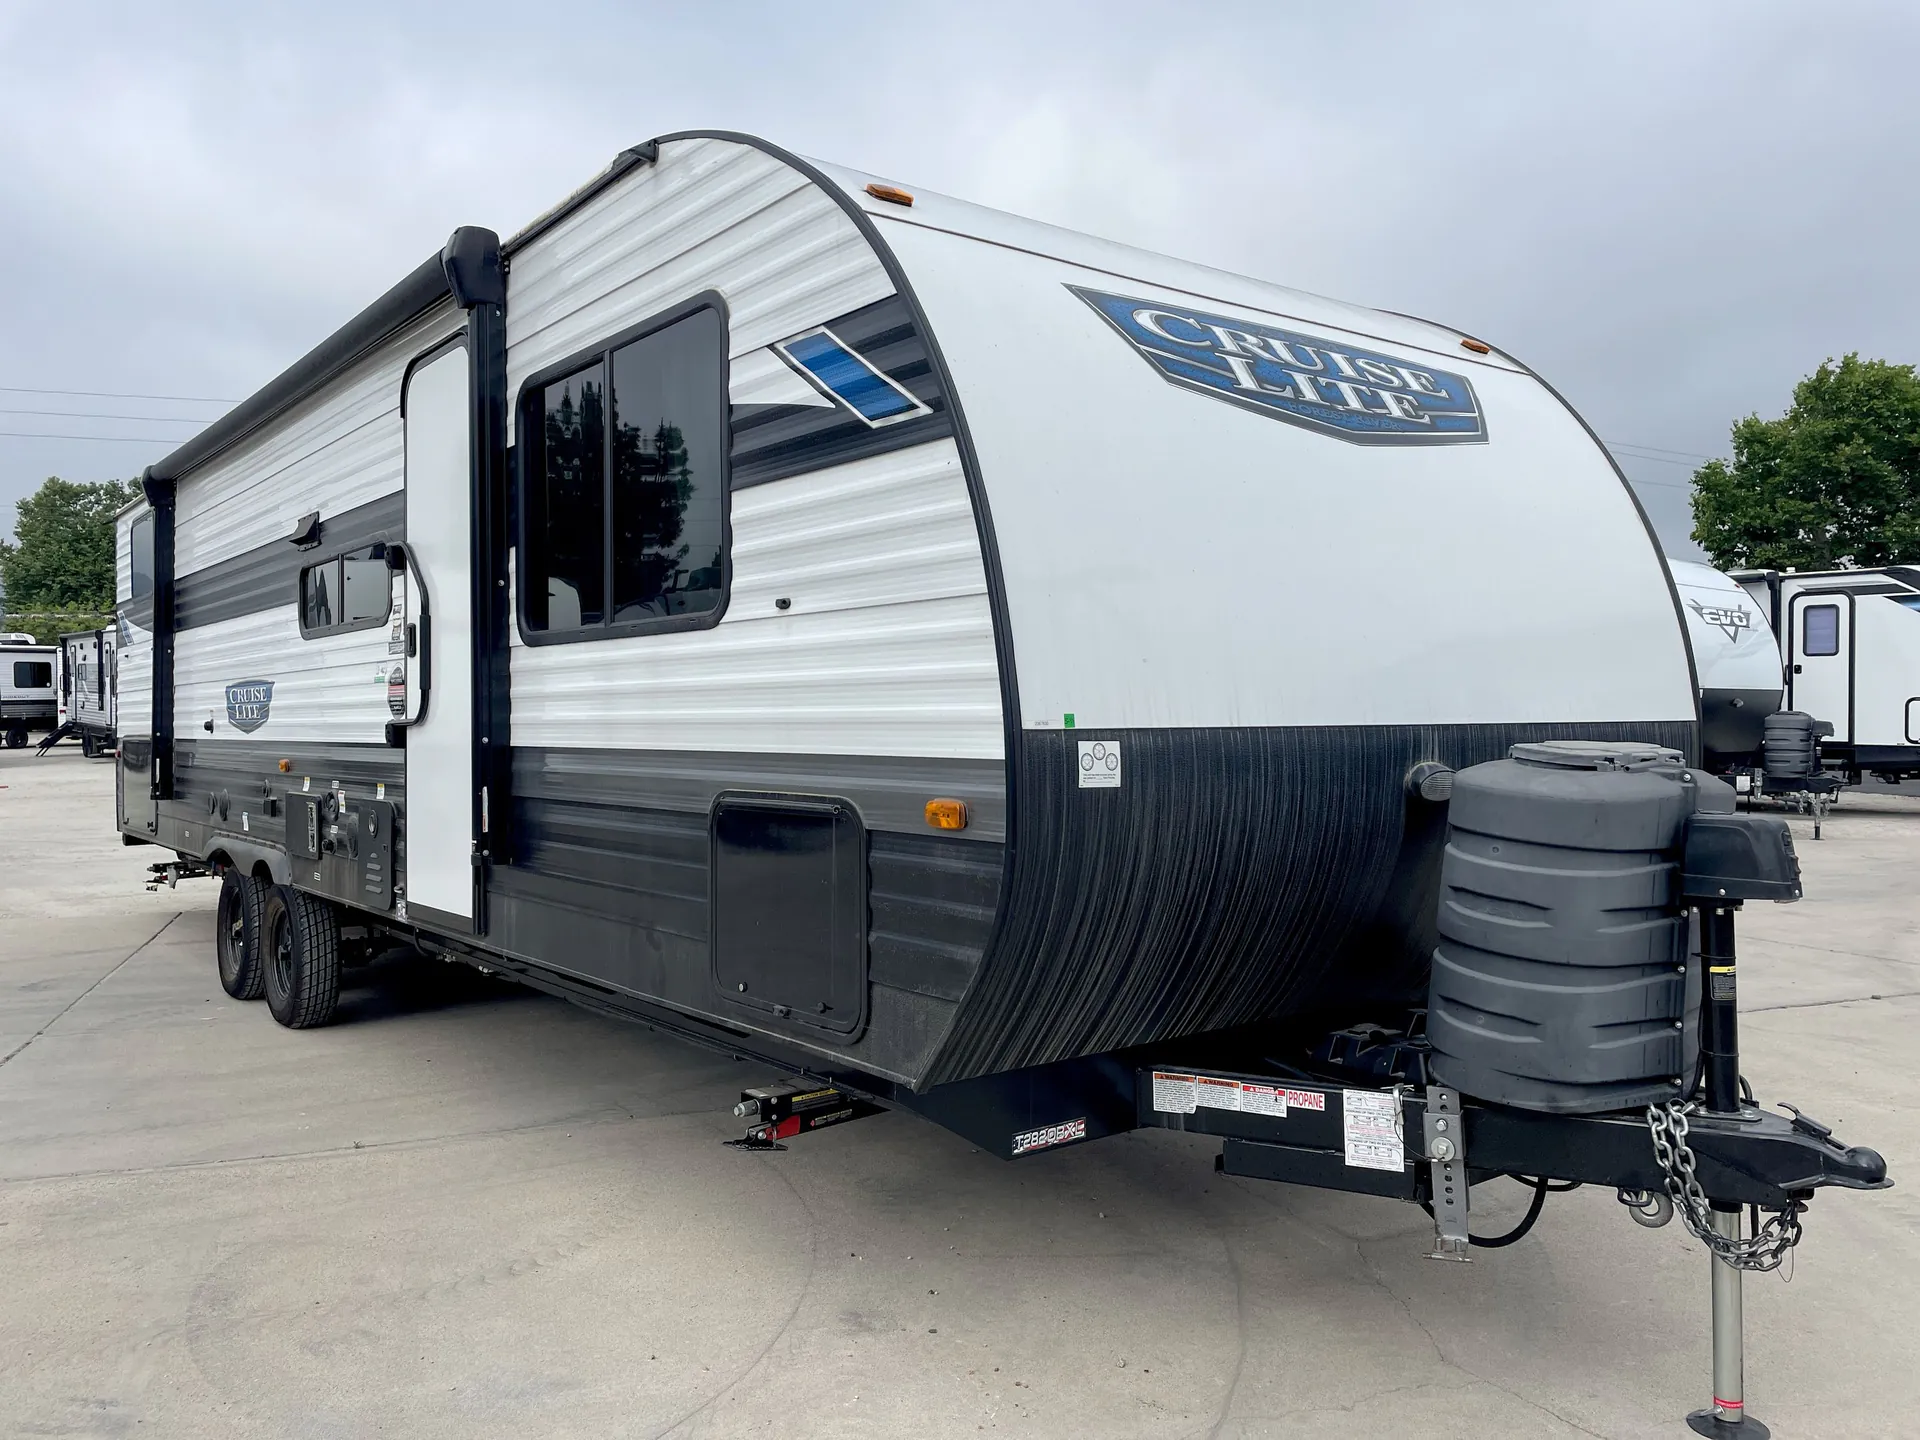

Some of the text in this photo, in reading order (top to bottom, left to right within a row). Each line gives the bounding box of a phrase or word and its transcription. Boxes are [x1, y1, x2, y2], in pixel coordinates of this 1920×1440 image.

[1132, 308, 1449, 400] CRUISE
[1215, 352, 1431, 425] LITE
[230, 686, 267, 704] CRUISE
[235, 704, 261, 720] LITE
[1288, 1090, 1324, 1109] PROPANE
